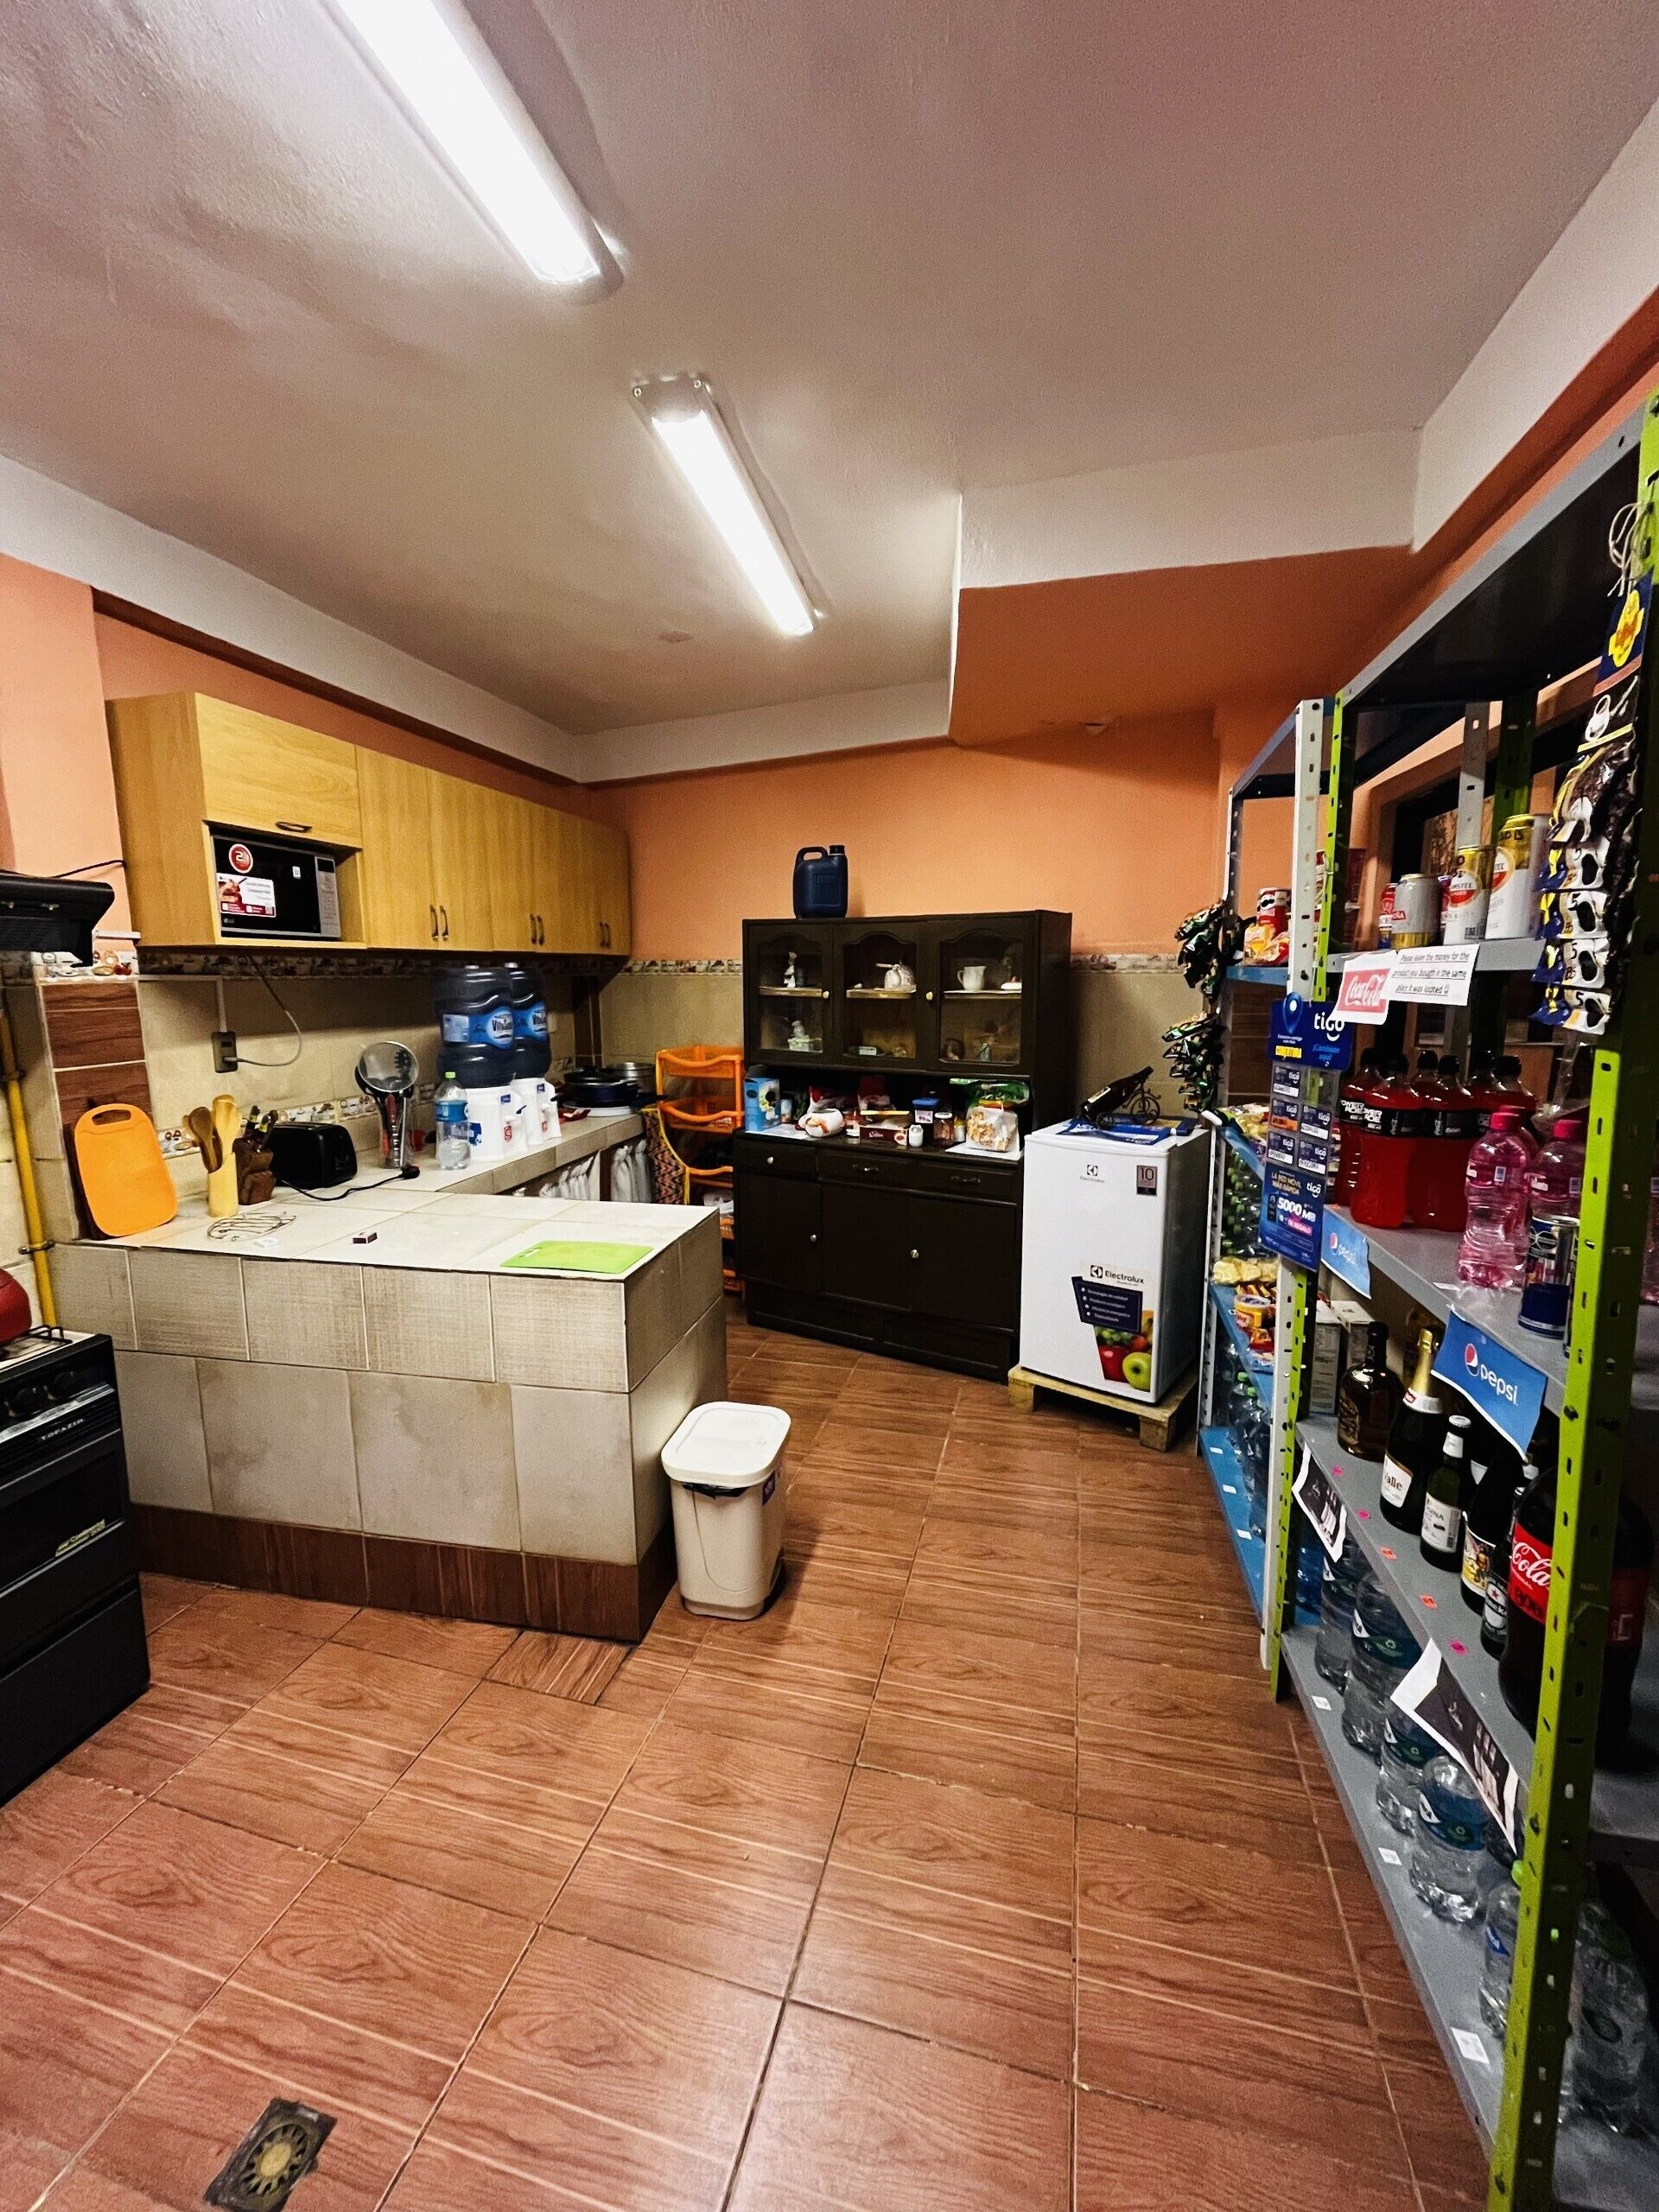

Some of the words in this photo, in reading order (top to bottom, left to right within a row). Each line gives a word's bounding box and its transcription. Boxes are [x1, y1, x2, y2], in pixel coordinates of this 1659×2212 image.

[1460, 951, 1470, 961] the
[1141, 1166, 1154, 1181] 10
[1277, 1197, 1303, 1217] 5000
[1104, 1270, 1145, 1284] Electrolux
[1480, 1363, 1518, 1405] pepsi
